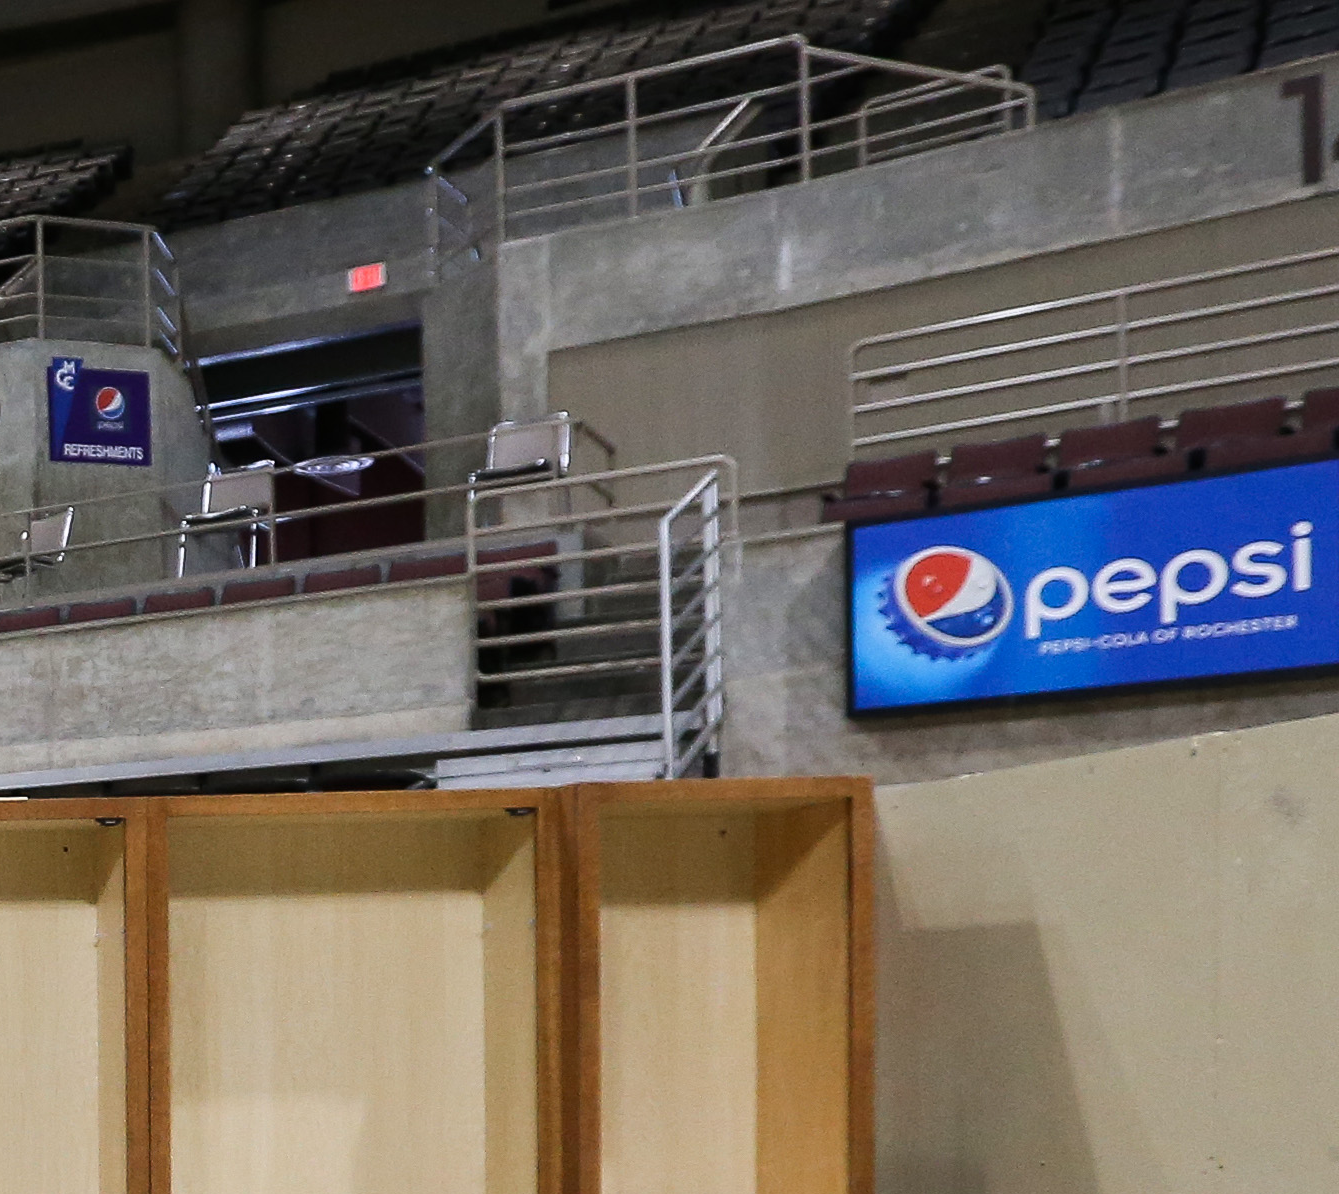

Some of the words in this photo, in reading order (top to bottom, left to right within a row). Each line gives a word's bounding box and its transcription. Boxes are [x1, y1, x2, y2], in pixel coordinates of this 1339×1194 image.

[63, 443, 144, 460] REFRESHMENTS
[1024, 520, 1314, 640] pepsi
[1038, 630, 1150, 656] PEPSI-COLA
[1151, 625, 1179, 645] OF
[1180, 614, 1299, 640] ROCHESTER
